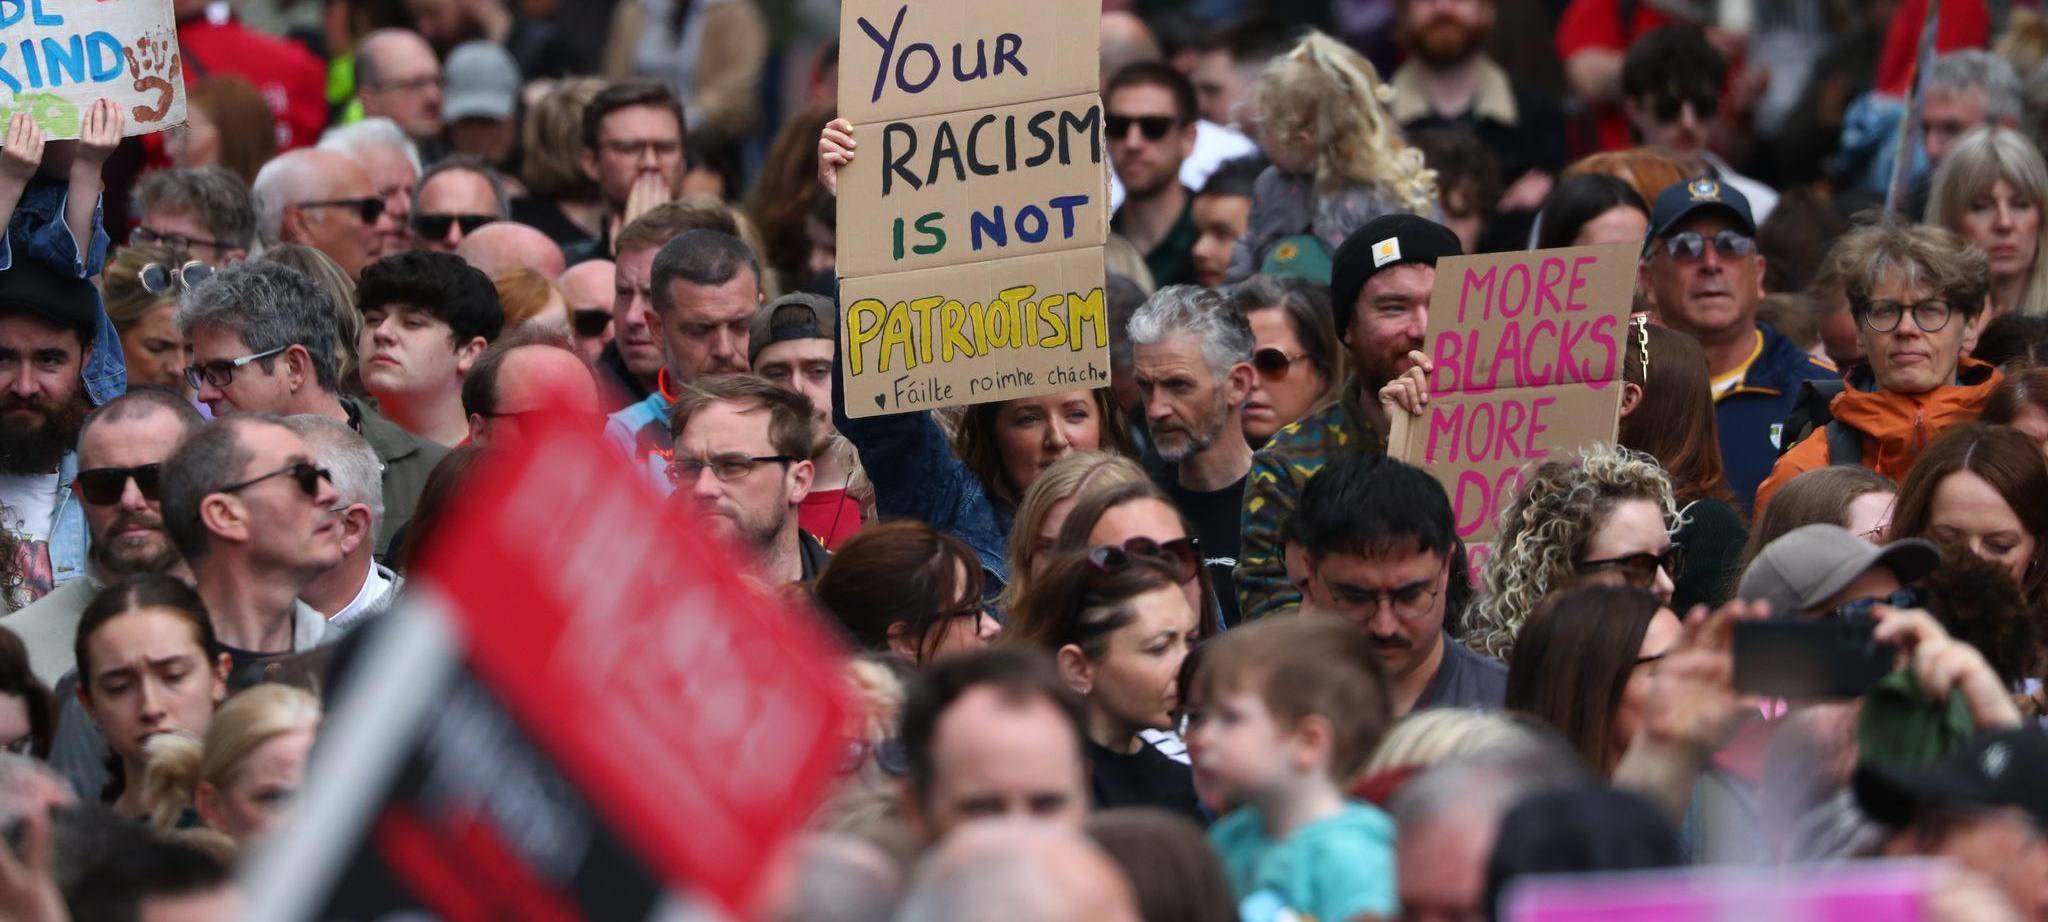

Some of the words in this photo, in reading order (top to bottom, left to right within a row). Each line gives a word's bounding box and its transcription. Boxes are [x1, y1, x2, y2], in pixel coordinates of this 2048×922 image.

[857, 5, 1028, 103] YOUR
[882, 105, 1100, 198] RACISM
[893, 212, 947, 261] IS
[970, 195, 1089, 250] NOT
[1457, 256, 1597, 323] MORE
[847, 284, 1107, 377] PATRIOTISM
[1430, 314, 1617, 398] BLACKS
[894, 375, 953, 408] Fáilte
[970, 368, 1036, 396] roimhe
[1047, 362, 1099, 386] chách
[1425, 396, 1556, 464] MORE
